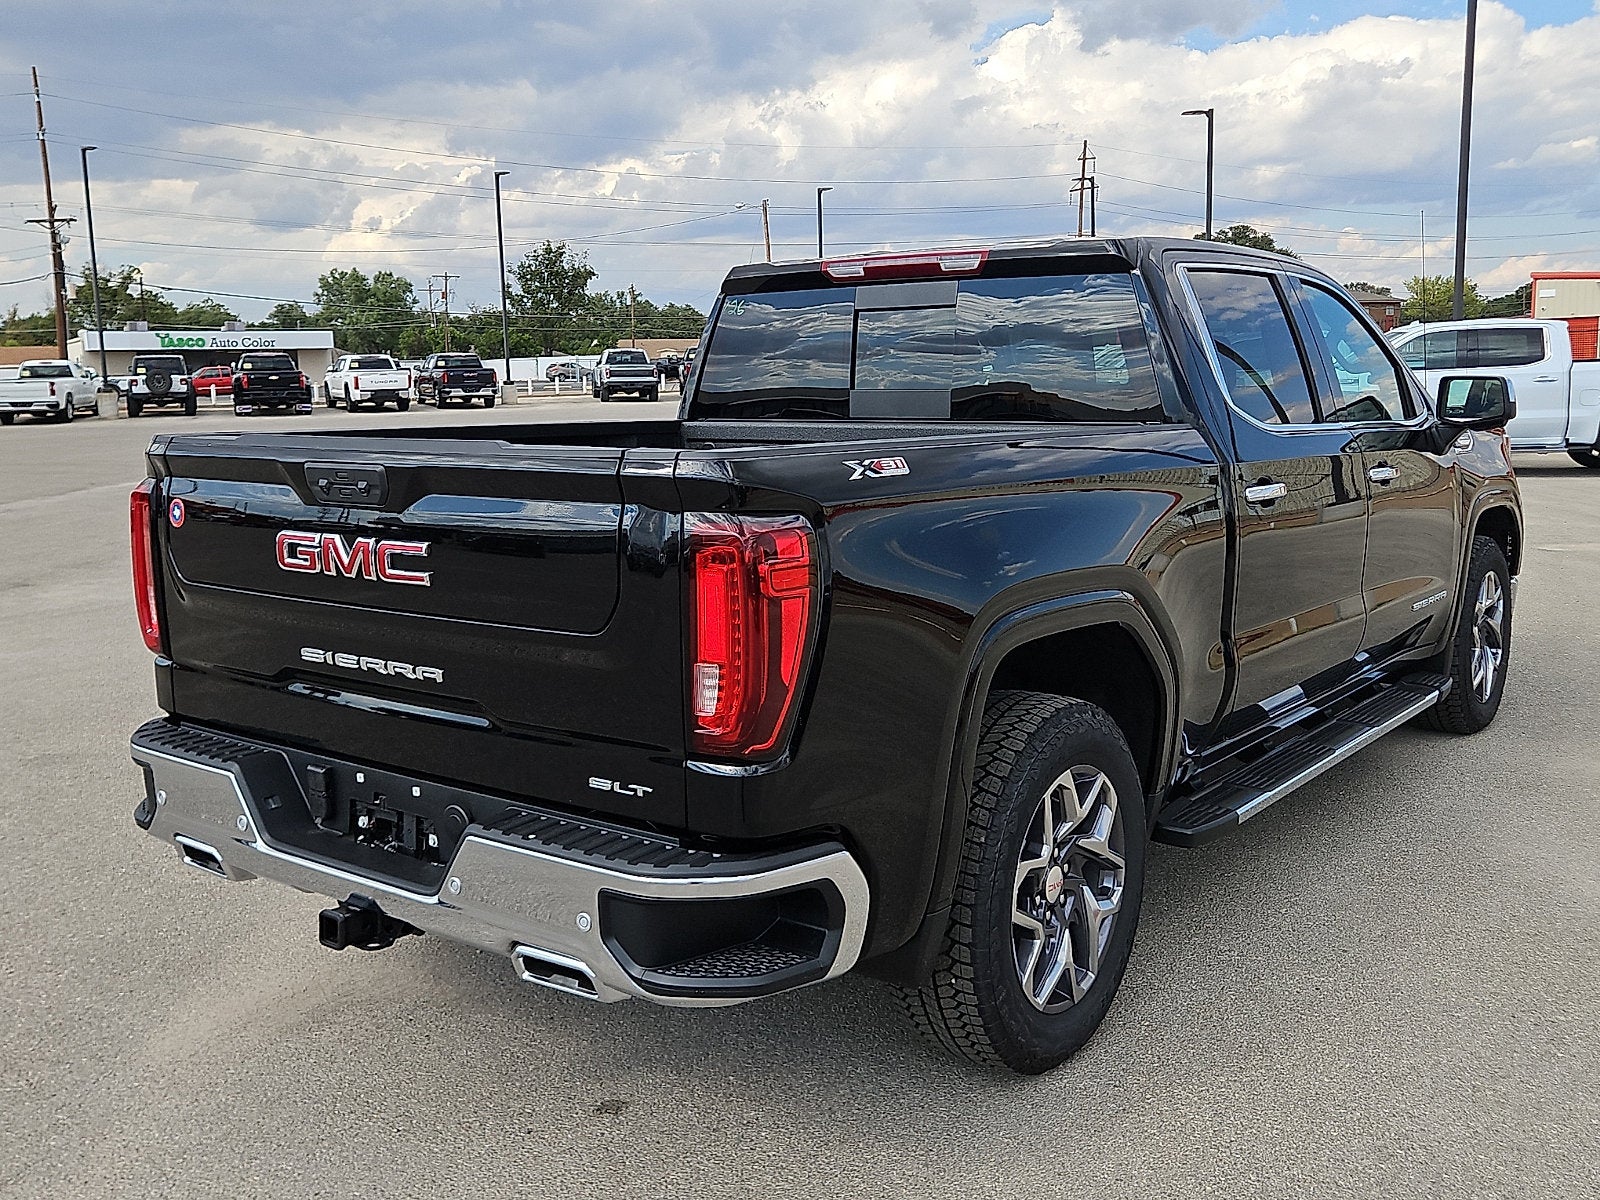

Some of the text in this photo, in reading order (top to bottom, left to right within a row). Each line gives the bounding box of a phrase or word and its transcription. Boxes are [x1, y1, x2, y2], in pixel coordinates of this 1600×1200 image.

[210, 337, 238, 348] Auto
[241, 337, 276, 348] Color
[275, 530, 433, 586] GMC
[1412, 590, 1448, 611] SIERRA
[300, 647, 444, 683] SIERRA
[588, 776, 654, 798] SLT
